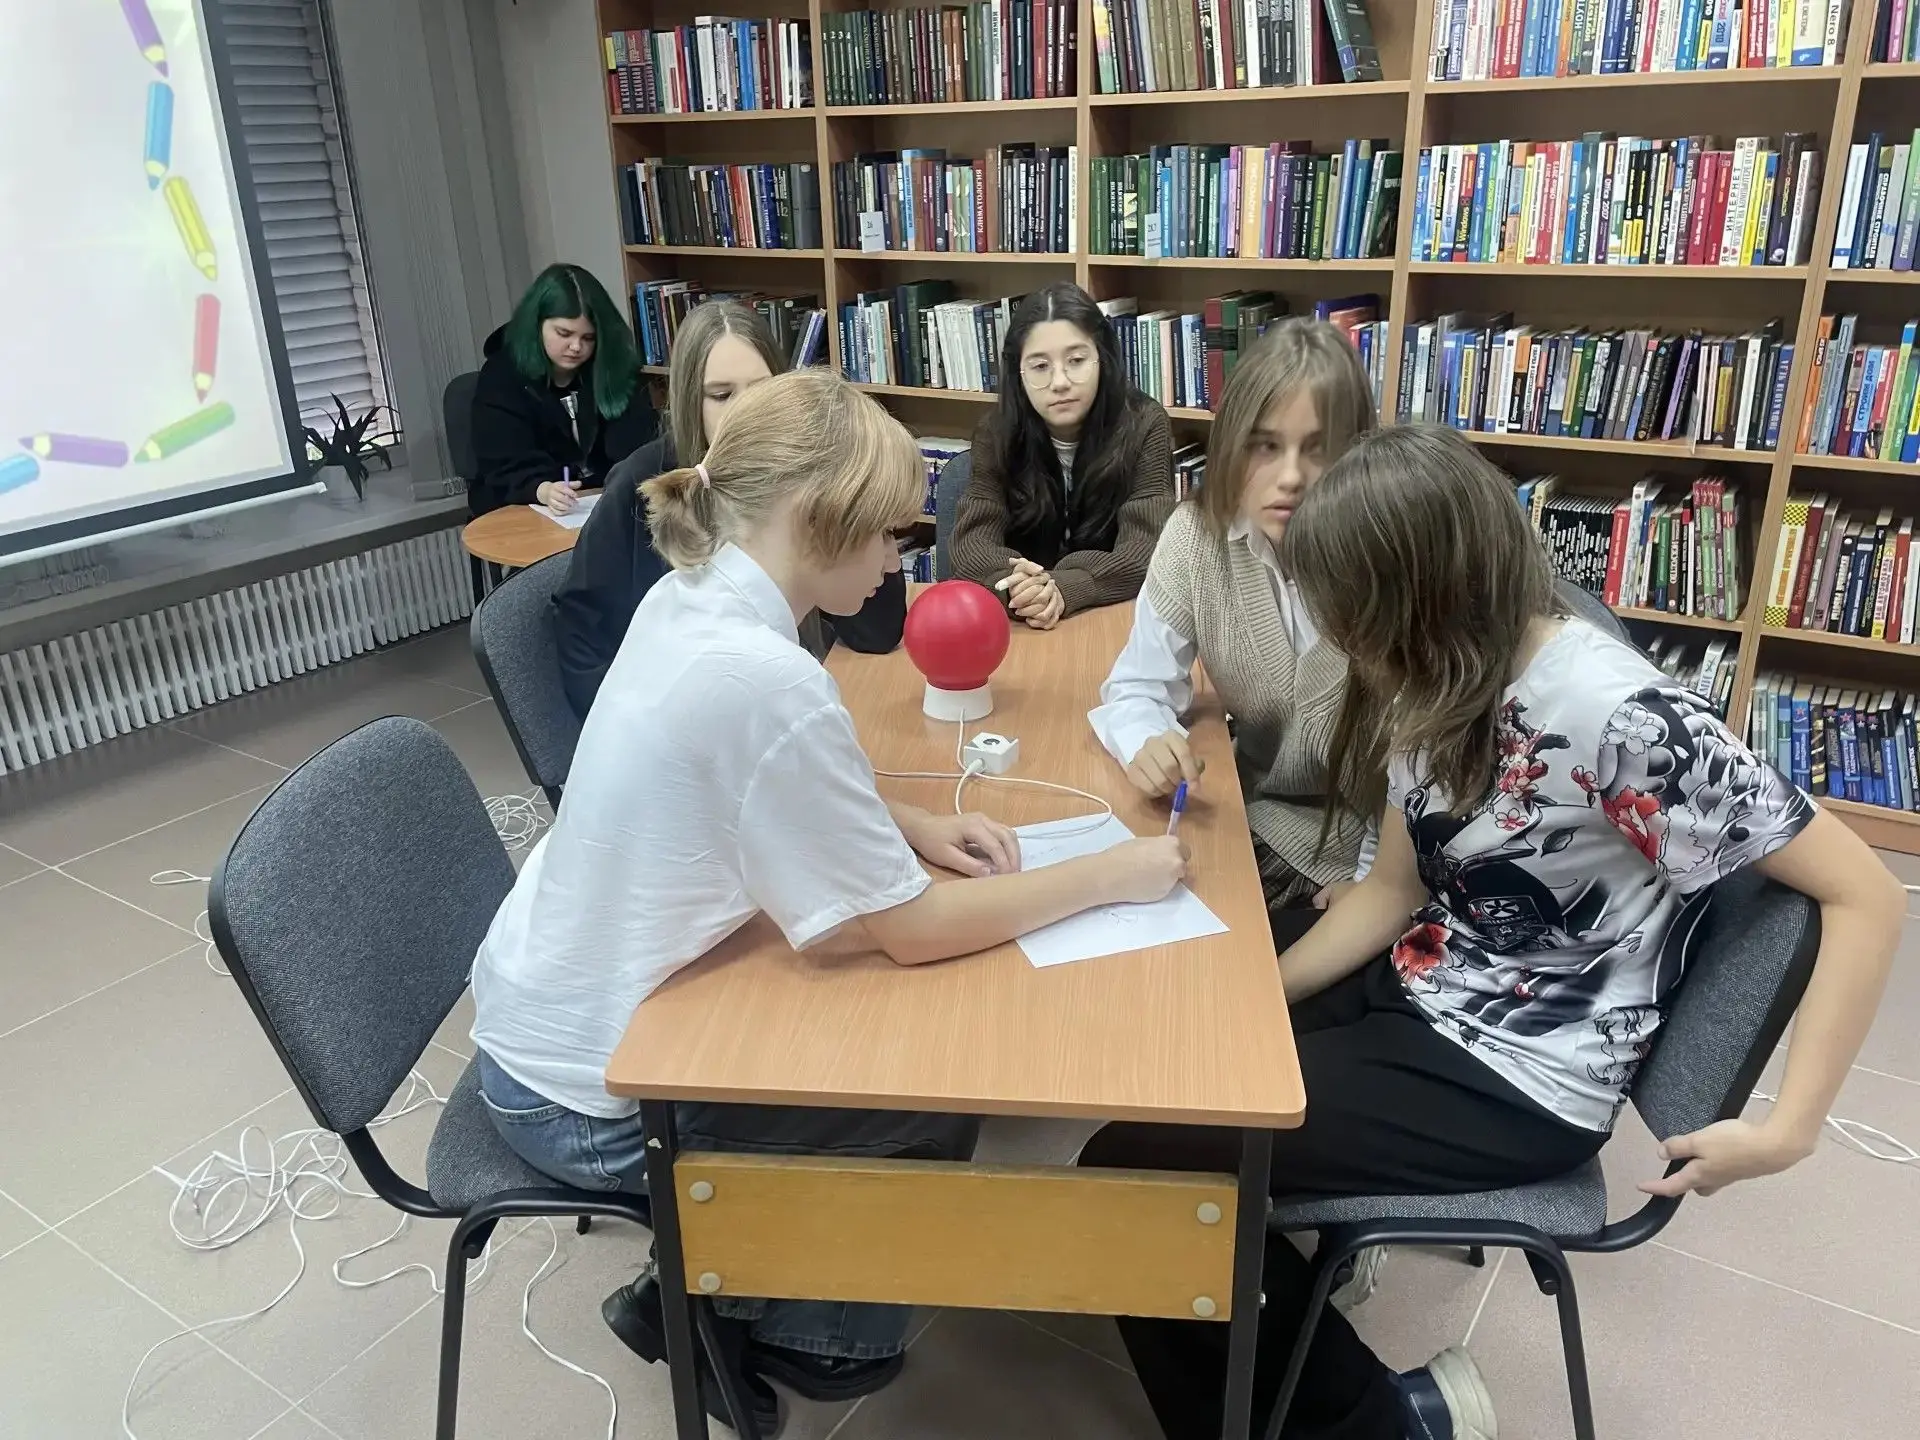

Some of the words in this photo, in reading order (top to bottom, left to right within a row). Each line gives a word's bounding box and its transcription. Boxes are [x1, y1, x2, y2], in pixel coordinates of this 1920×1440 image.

[1828, 4, 1839, 35] Nero
[1827, 38, 1835, 46] 8
[1548, 179, 1558, 200] Office
[1603, 178, 1612, 199] Office
[1682, 159, 1694, 196] ХАКЕРОВ
[975, 169, 984, 233] КЛИМАТОЛОГИЯ
[1579, 192, 1590, 230] Windows
[1601, 200, 1610, 220] 2007
[1875, 172, 1890, 220] СПРАВОЧНИК
[1458, 206, 1470, 242] Windows
[1721, 255, 1729, 263] Я
[1725, 167, 1741, 232] ИНТЕРНЕТ
[1577, 231, 1587, 253] Vista
[1659, 232, 1668, 251] Sony
[1861, 360, 1876, 382] ДОМ
[1876, 558, 1890, 604] АВТОМОБИЛЬ
